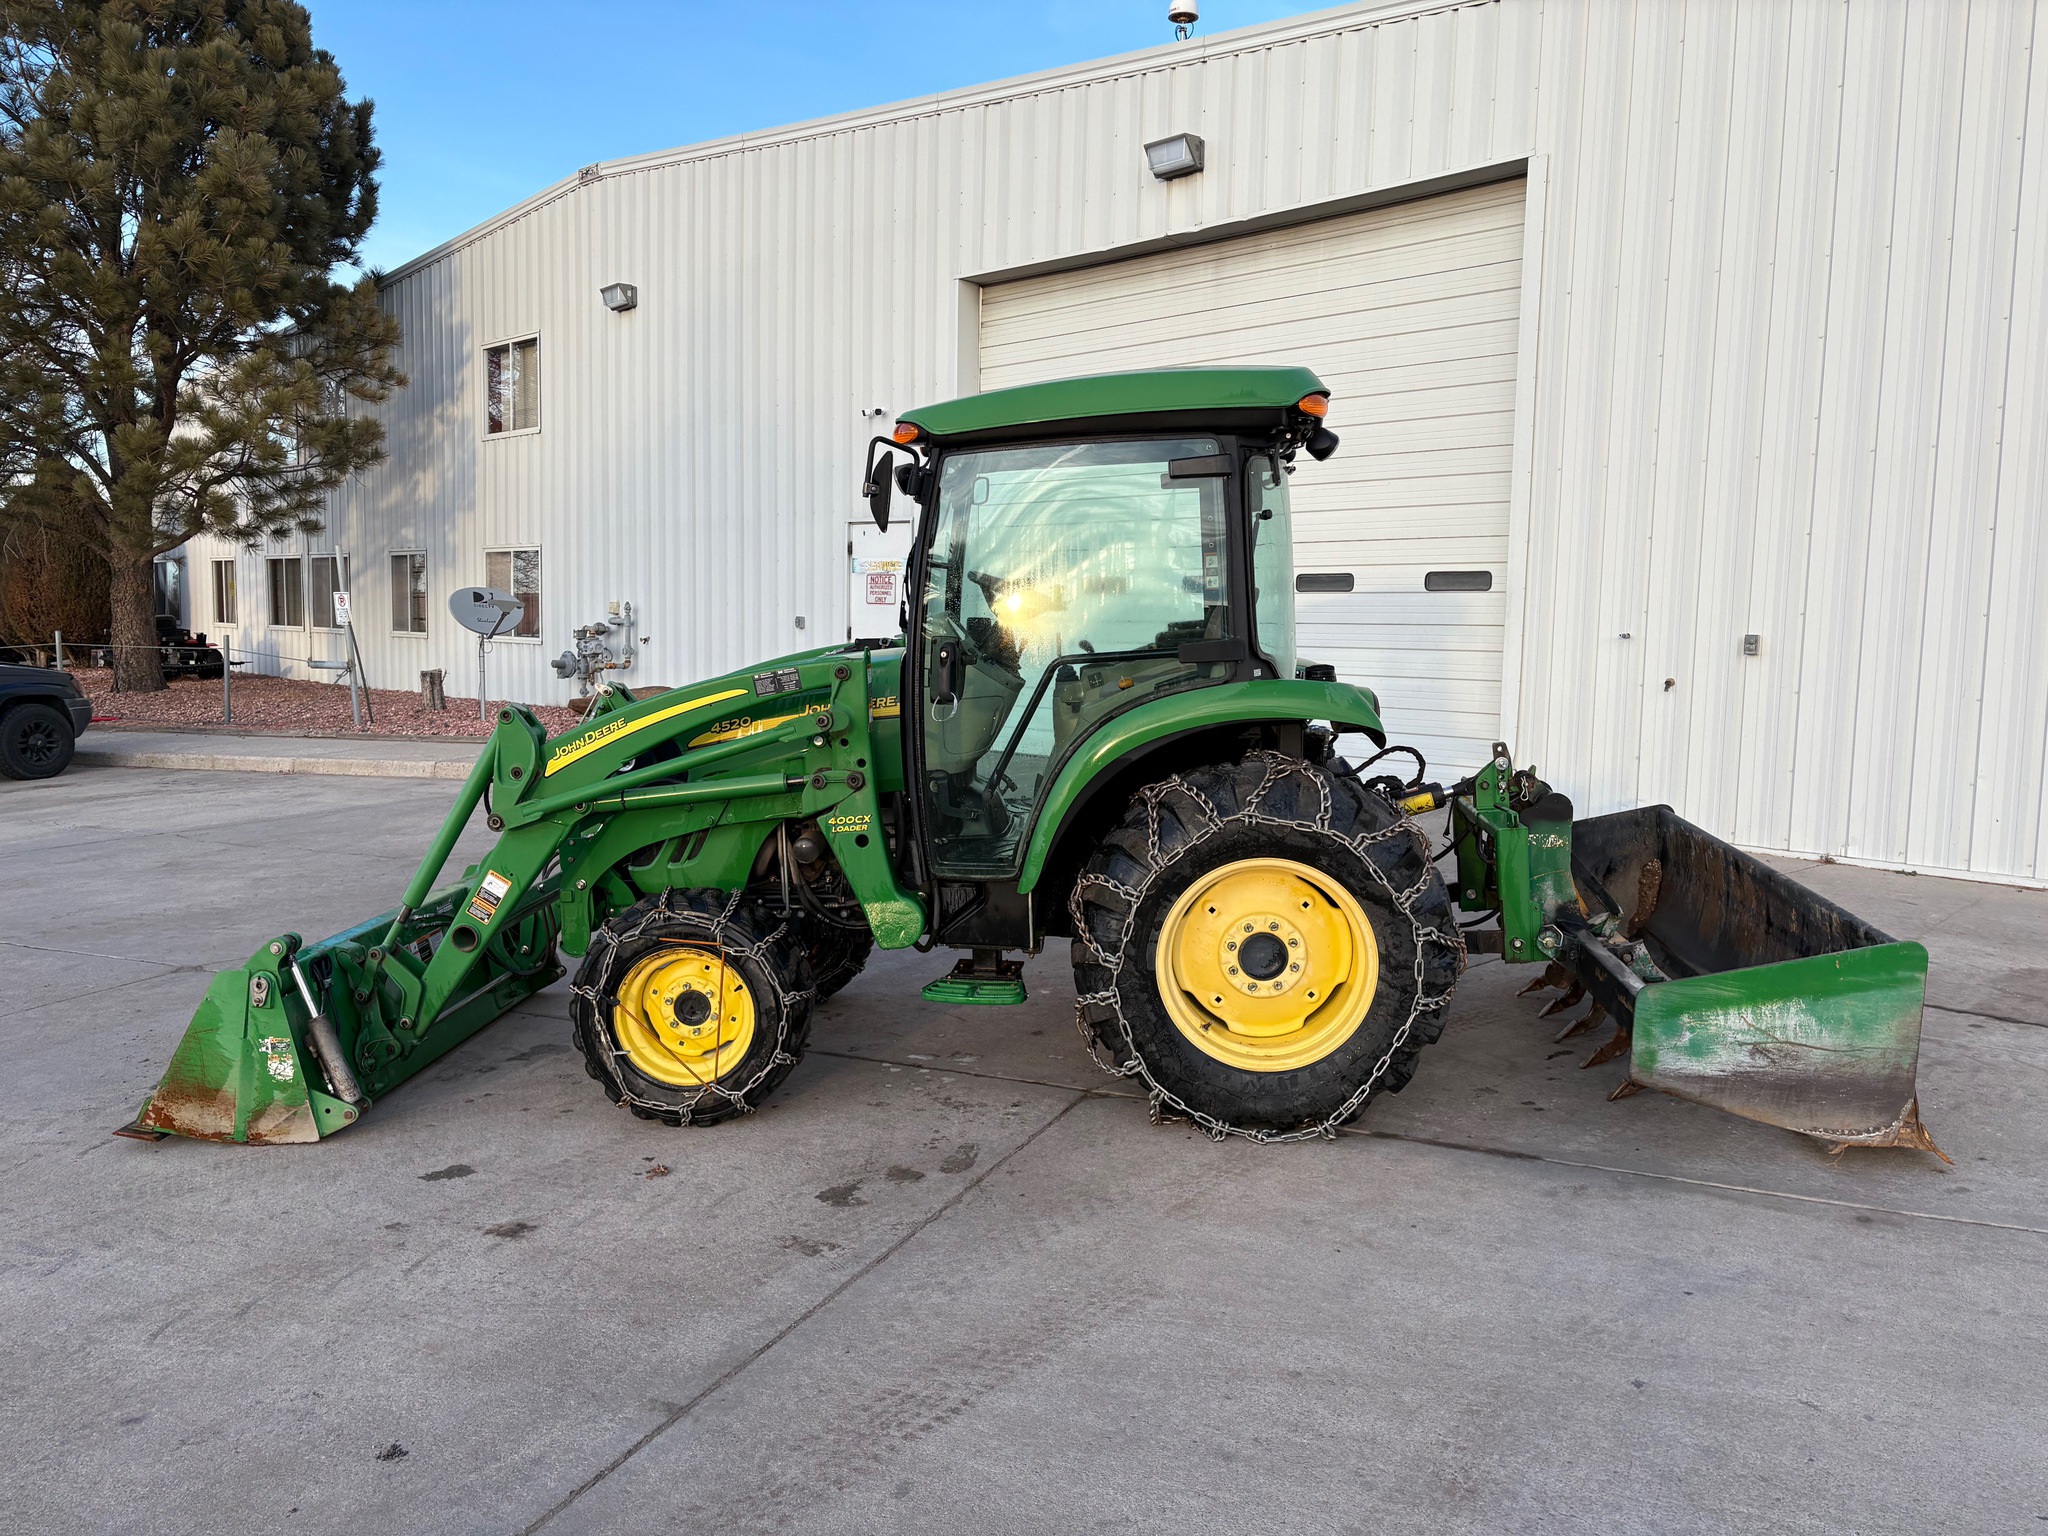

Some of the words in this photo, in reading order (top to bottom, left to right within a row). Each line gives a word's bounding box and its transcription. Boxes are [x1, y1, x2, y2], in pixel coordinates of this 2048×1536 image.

[710, 716, 752, 733] 4520
[553, 737, 586, 761] JOHN
[584, 717, 628, 746] DEERE
[828, 814, 872, 825] 400CX
[832, 824, 868, 833] LOADER
